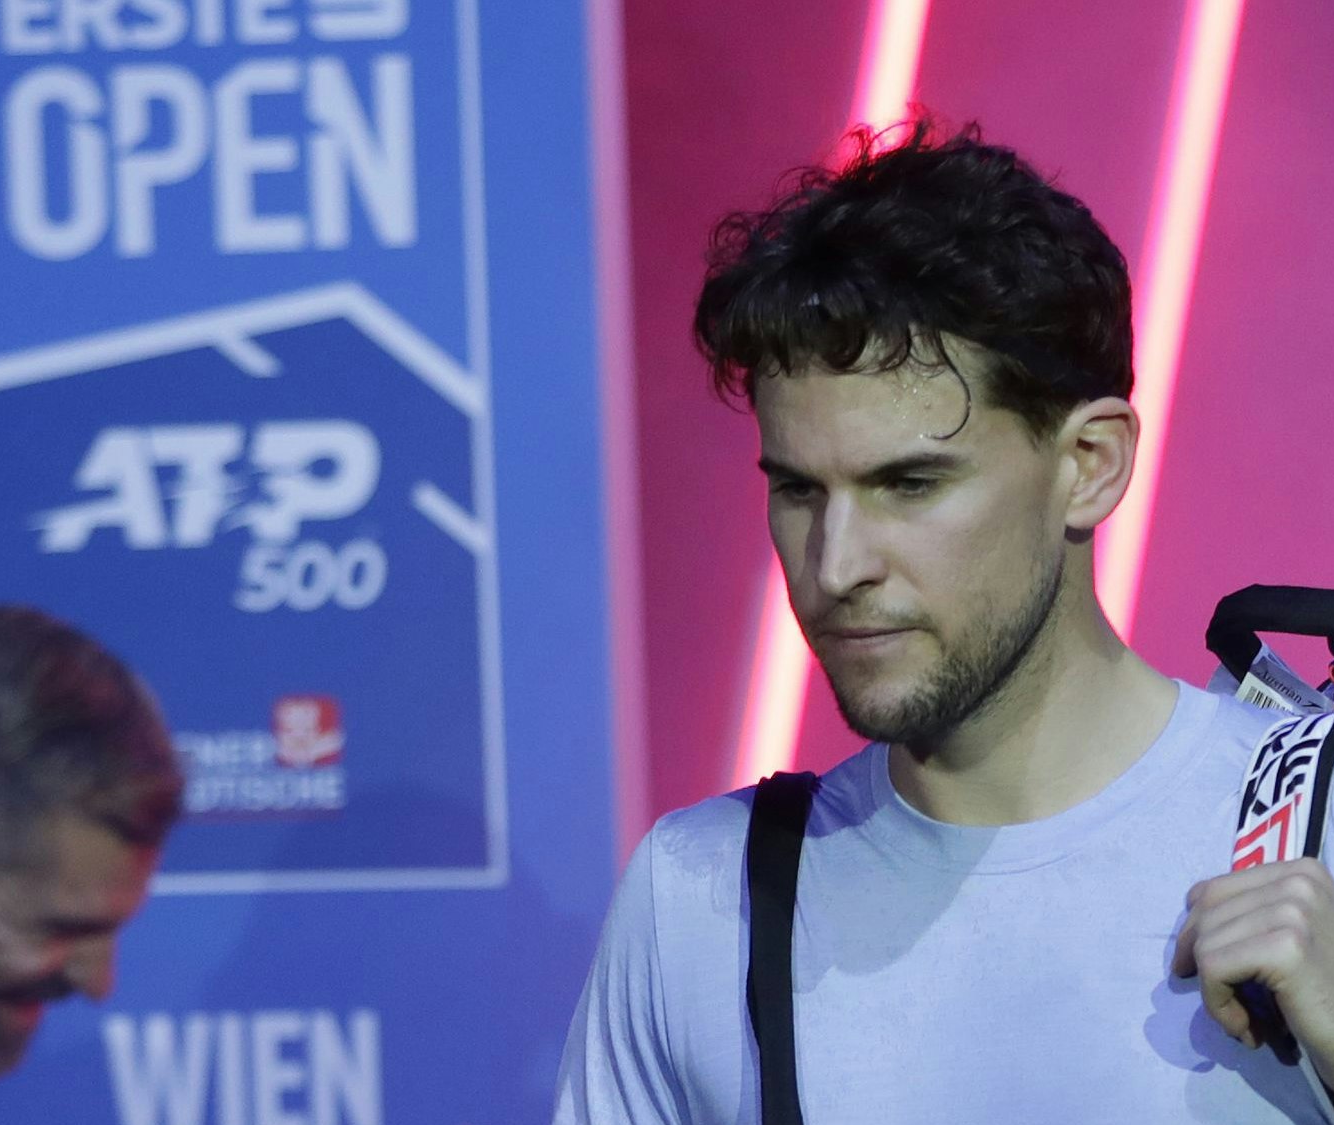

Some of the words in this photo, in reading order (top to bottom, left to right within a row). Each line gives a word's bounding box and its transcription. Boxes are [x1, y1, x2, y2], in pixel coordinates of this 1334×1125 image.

[4, 54, 417, 260] OPEN
[31, 420, 381, 553] ATP
[235, 538, 386, 611] 500
[1255, 667, 1303, 704] Austrian
